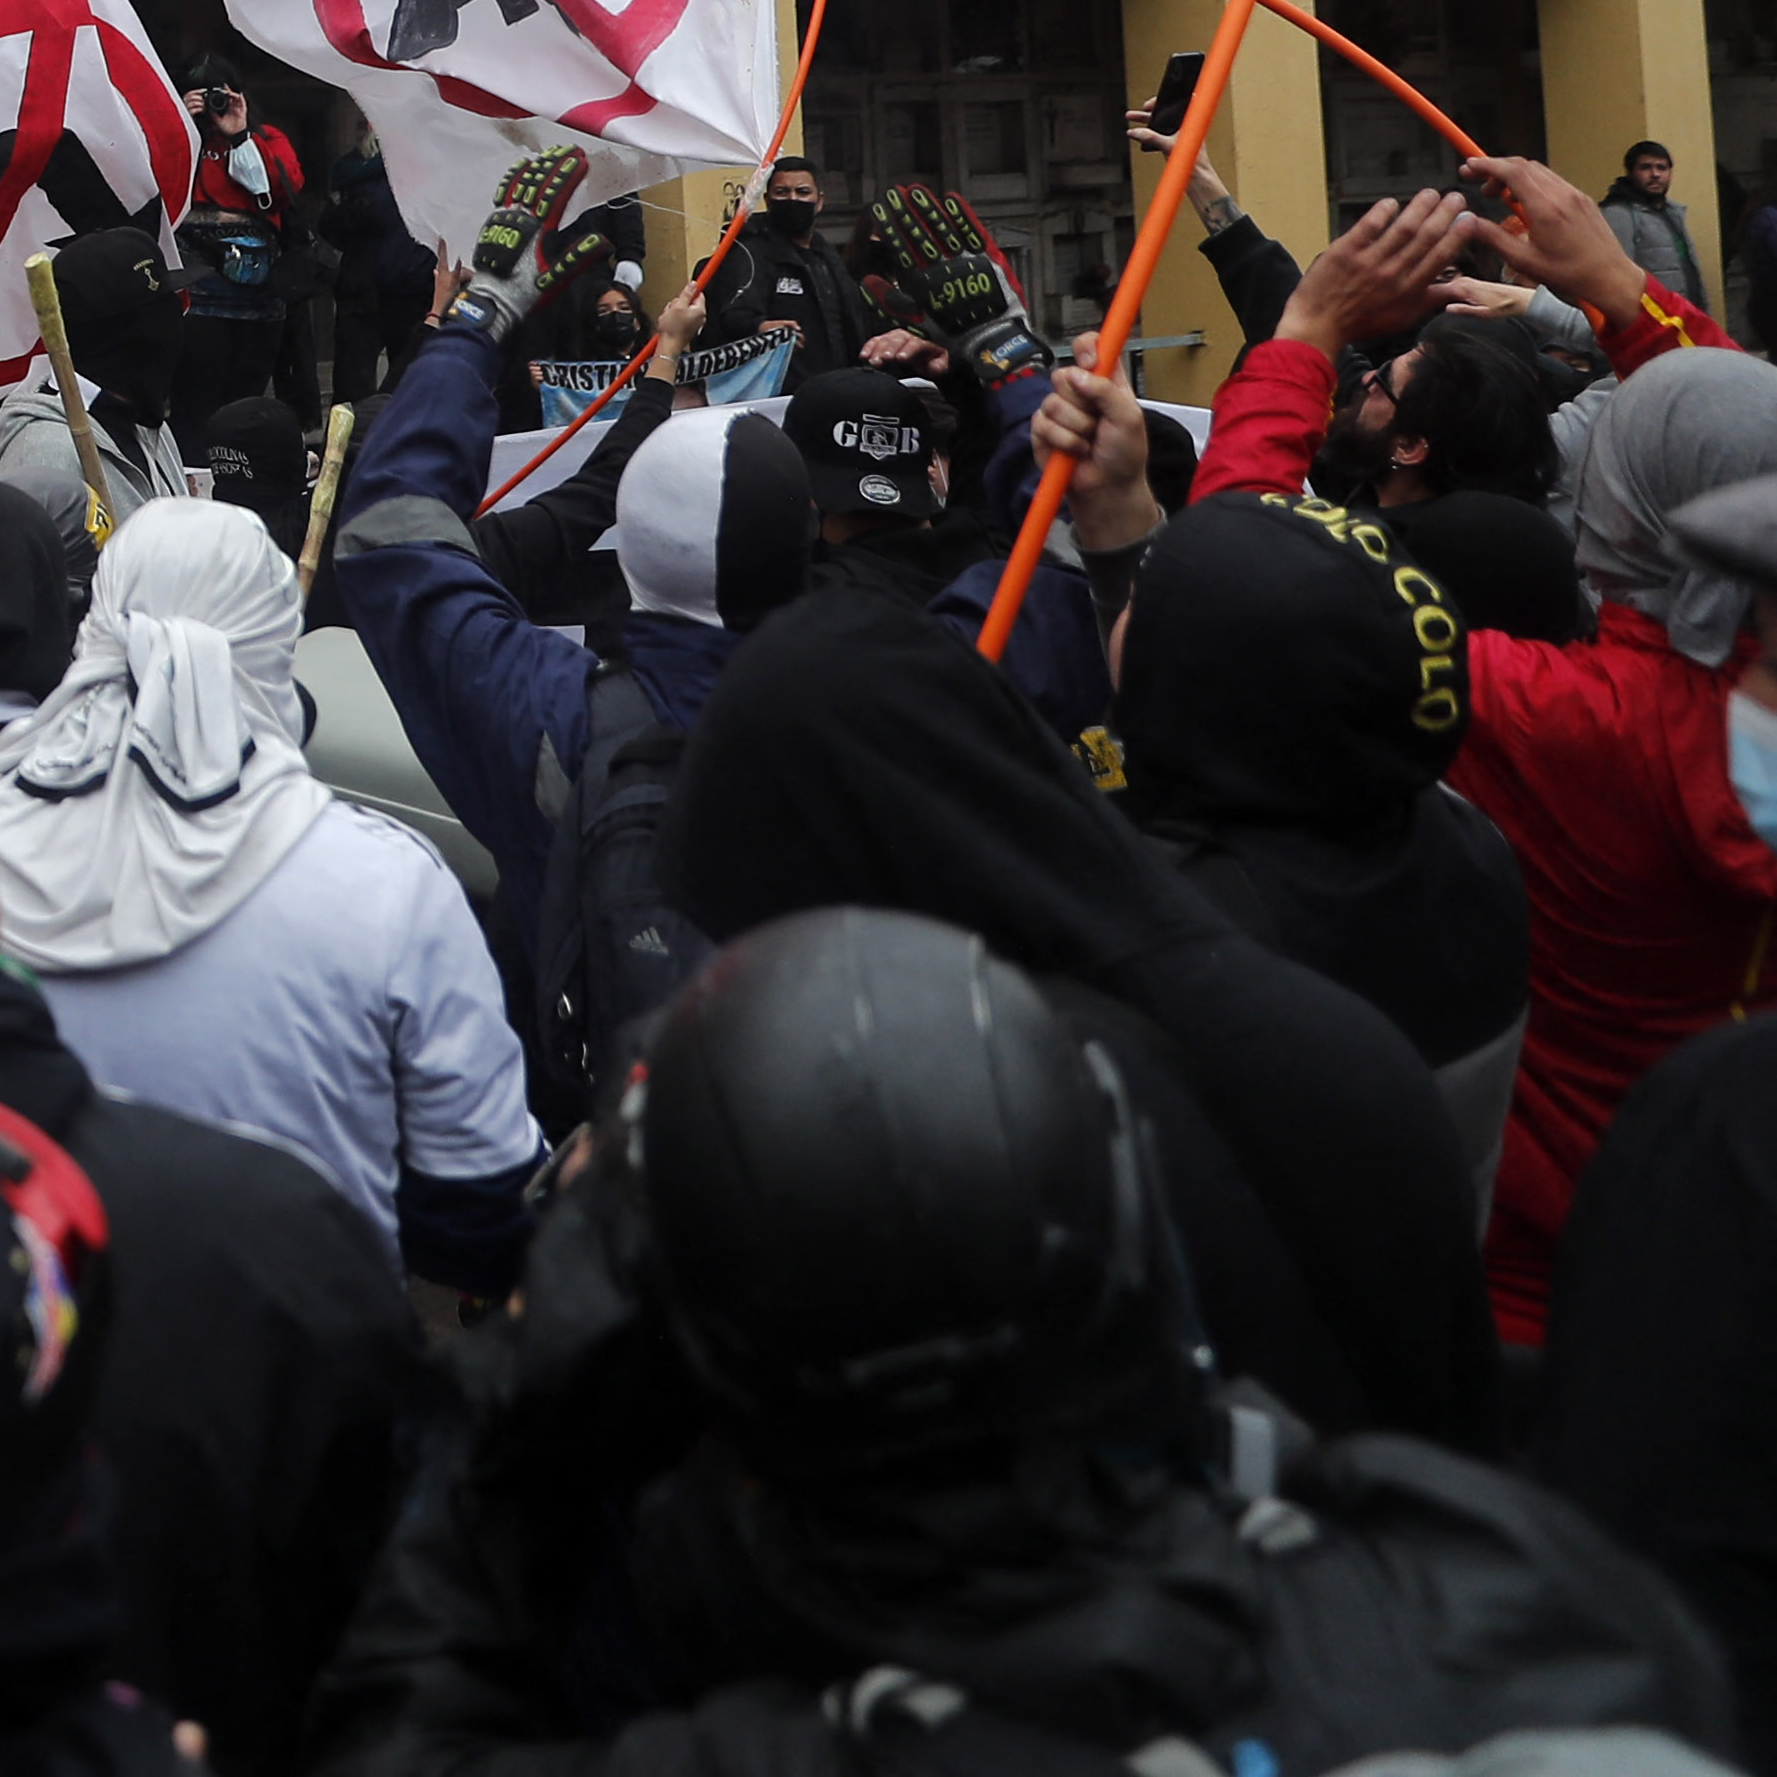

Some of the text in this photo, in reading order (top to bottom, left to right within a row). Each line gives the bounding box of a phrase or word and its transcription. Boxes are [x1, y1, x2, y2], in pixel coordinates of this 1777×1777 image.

[929, 272, 993, 311] L-9160
[674, 326, 795, 384] ALDEBENITO
[832, 419, 921, 454] G B
